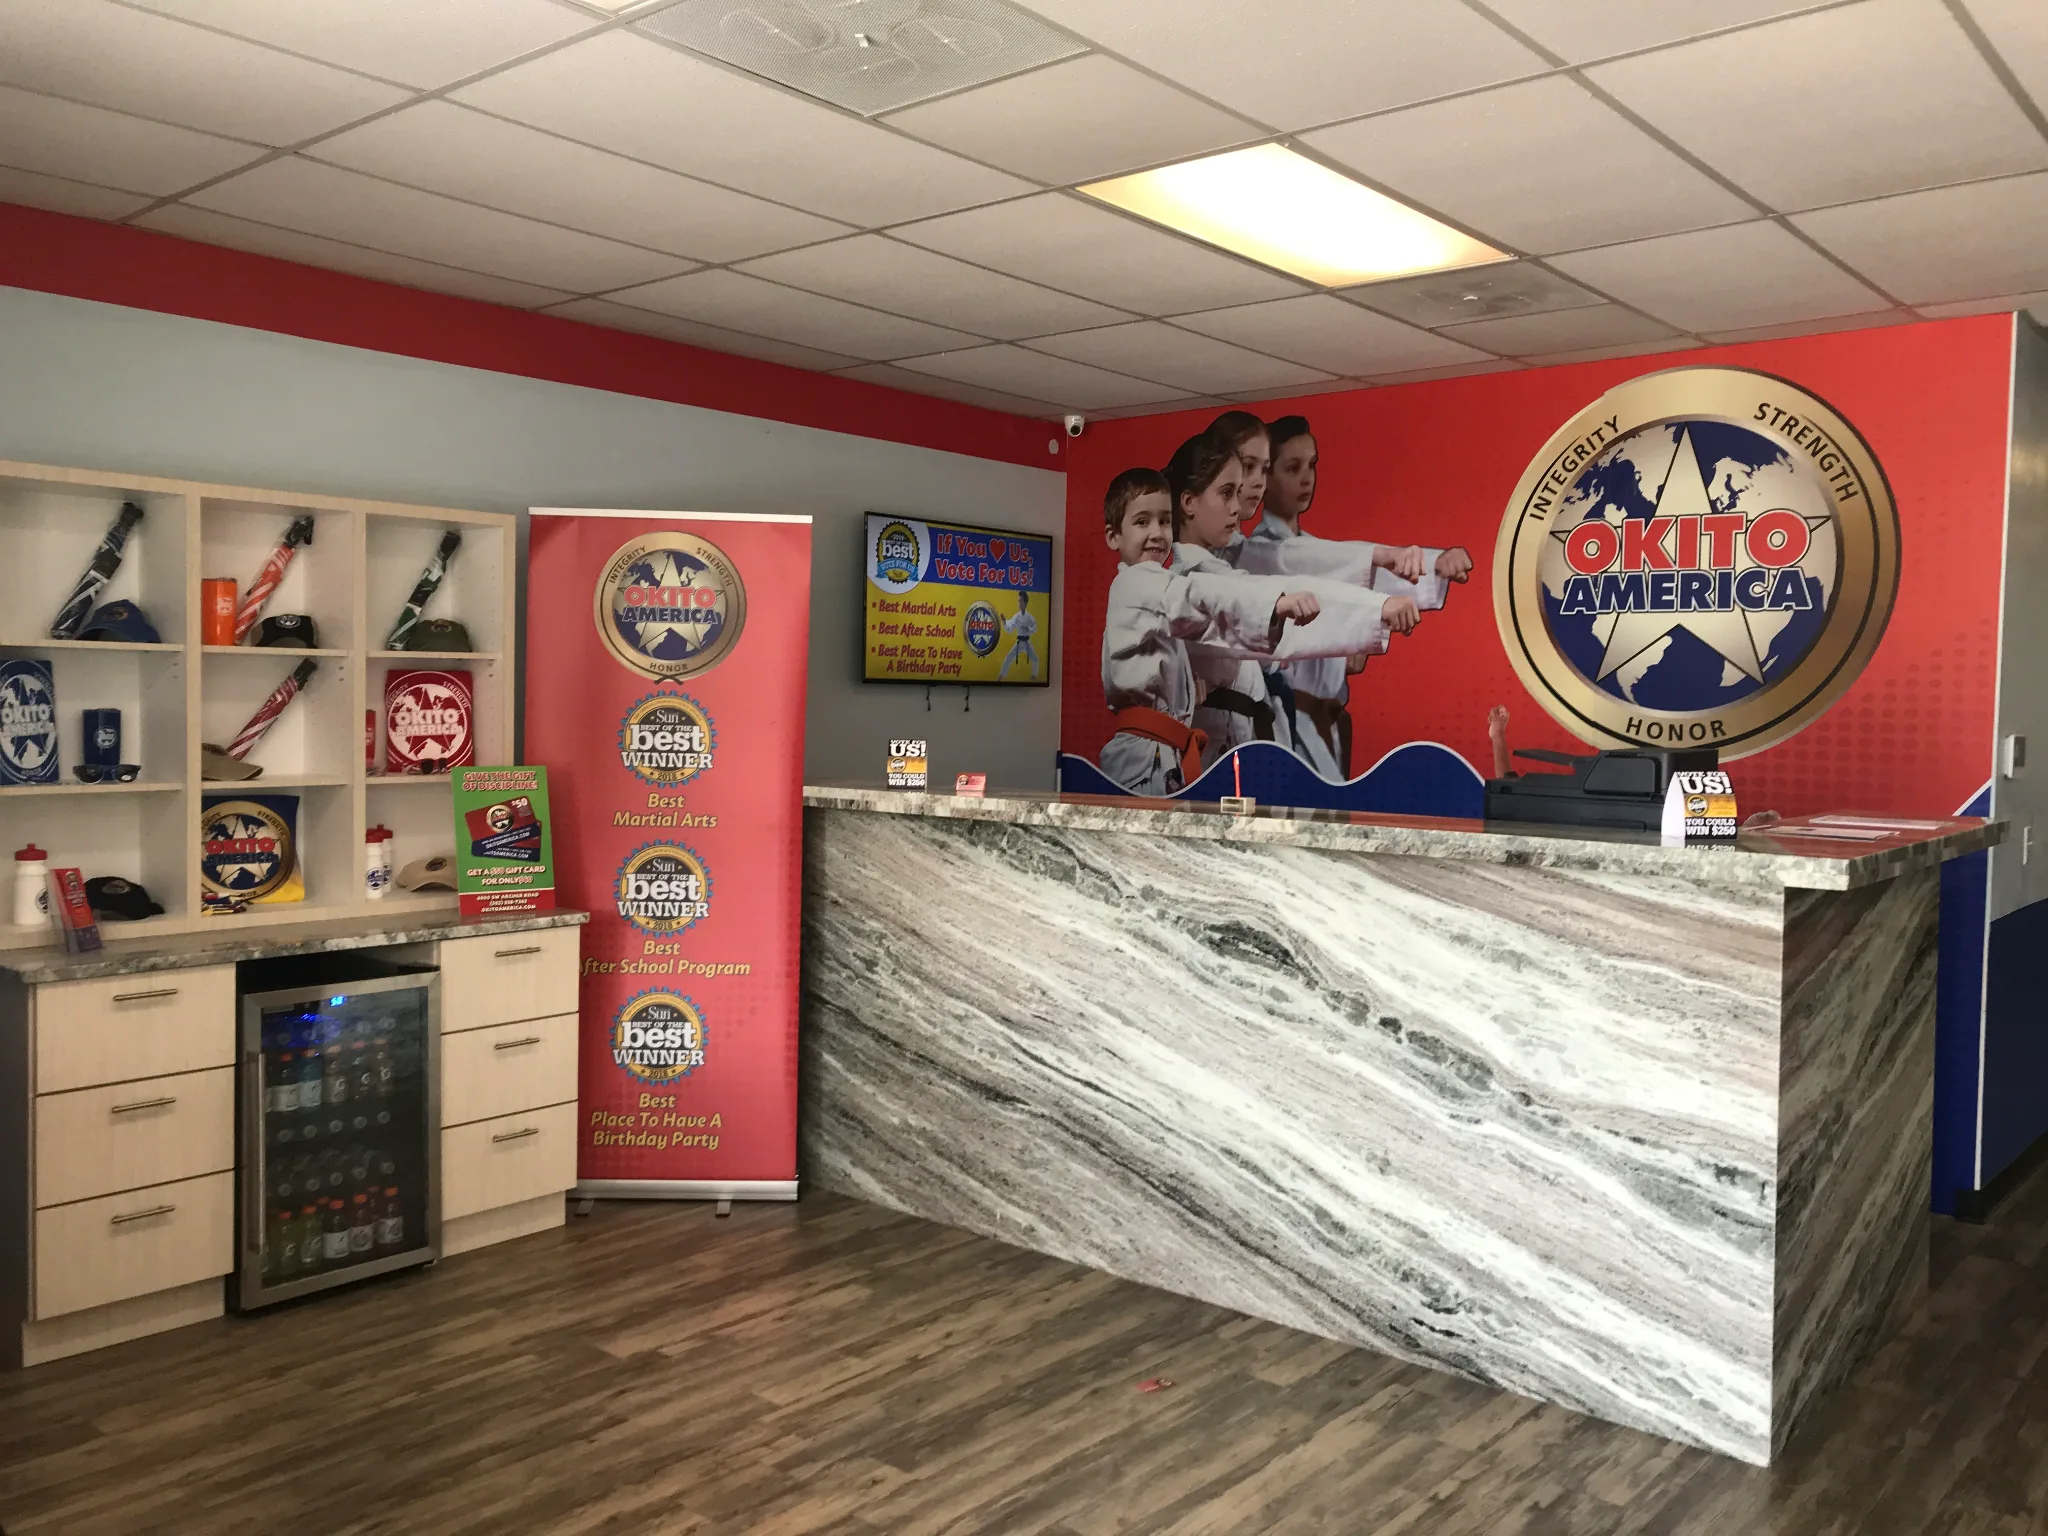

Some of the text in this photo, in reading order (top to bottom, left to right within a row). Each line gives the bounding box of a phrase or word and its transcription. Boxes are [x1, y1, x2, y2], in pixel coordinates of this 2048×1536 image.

[1753, 401, 1859, 503] STRENGTH
[1529, 414, 1618, 521] INTEGRITY
[1563, 507, 1812, 574] OKITO
[882, 539, 914, 560] best
[936, 534, 1034, 568] If You Us,
[608, 545, 648, 584] INTEGRITY
[696, 546, 733, 587] STRENGTH
[896, 560, 908, 570] FOR
[935, 558, 1034, 587] Vote For Us!
[623, 586, 718, 608] OKITO
[1560, 566, 1813, 614] AMERICA
[622, 606, 718, 624] AMERICA
[878, 600, 900, 612] Best
[901, 600, 936, 616] Martial
[938, 604, 957, 617] Arts
[878, 622, 900, 635] Best
[900, 622, 924, 638] After
[926, 624, 955, 638] School
[878, 644, 963, 660] Best Place To Have
[650, 662, 688, 673] HONOR
[886, 660, 962, 677] A Birthday Party
[2, 703, 50, 724] OKITO
[395, 708, 460, 727] OKITO
[656, 709, 679, 724] Sun
[396, 724, 464, 736] AMERICA
[662, 724, 674, 732] OF
[1625, 716, 1727, 741] HONOR
[630, 724, 706, 752] best
[890, 744, 926, 757] US!
[622, 752, 714, 768] WINNER
[464, 770, 536, 782] GIVE THE GIFT
[656, 772, 678, 781] 2018
[888, 778, 905, 786] WIN
[462, 781, 478, 792] OF
[1680, 776, 1732, 794] US!
[511, 798, 528, 808] $50
[647, 794, 686, 809] Best
[613, 812, 718, 828] Martial Arts
[1686, 818, 1736, 826] YOU COULD
[1686, 826, 1736, 836] WIN $250
[206, 836, 276, 855] OKITO
[467, 868, 483, 876] GET
[484, 868, 490, 876] A
[505, 866, 522, 876] GIFT
[522, 865, 546, 874] CARD
[652, 859, 676, 872] Sun
[482, 877, 498, 886] FOR
[499, 876, 520, 884] ONLY
[626, 874, 701, 900] best
[617, 900, 710, 918] WINNER
[652, 920, 673, 930] 2018
[643, 940, 681, 956] Best
[580, 957, 751, 976] fter School Program
[648, 1006, 671, 1020] Sun
[622, 1022, 698, 1049] best
[613, 1050, 705, 1066] WINNER
[648, 1068, 668, 1078] 2018
[638, 1093, 676, 1108] Best
[591, 1112, 722, 1128] Place To Have A
[592, 1130, 720, 1151] Birthday Party
